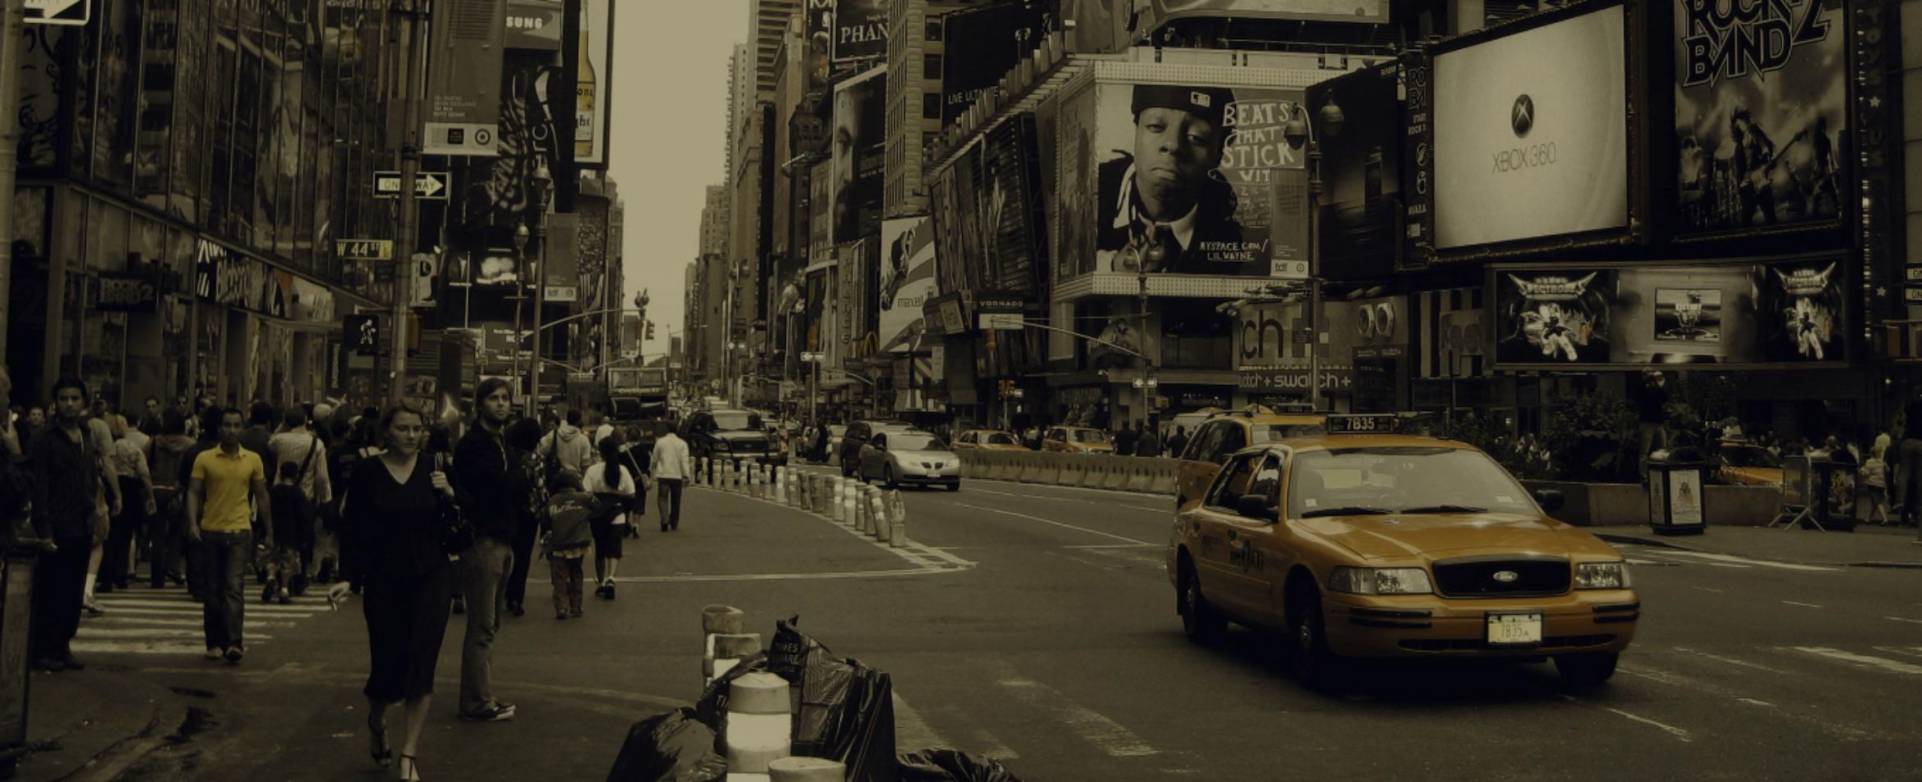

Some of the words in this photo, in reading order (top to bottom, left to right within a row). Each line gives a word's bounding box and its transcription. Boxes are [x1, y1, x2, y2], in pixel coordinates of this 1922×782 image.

[1682, 18, 1793, 87] BAND
[1223, 103, 1289, 127] BEATS
[1231, 126, 1280, 144] THAT
[1221, 143, 1295, 168] STICK
[1492, 146, 1529, 174] XBOX
[1531, 141, 1557, 167] 360
[337, 242, 346, 256] W
[351, 242, 368, 256] 44
[1346, 416, 1375, 431] 7B35
